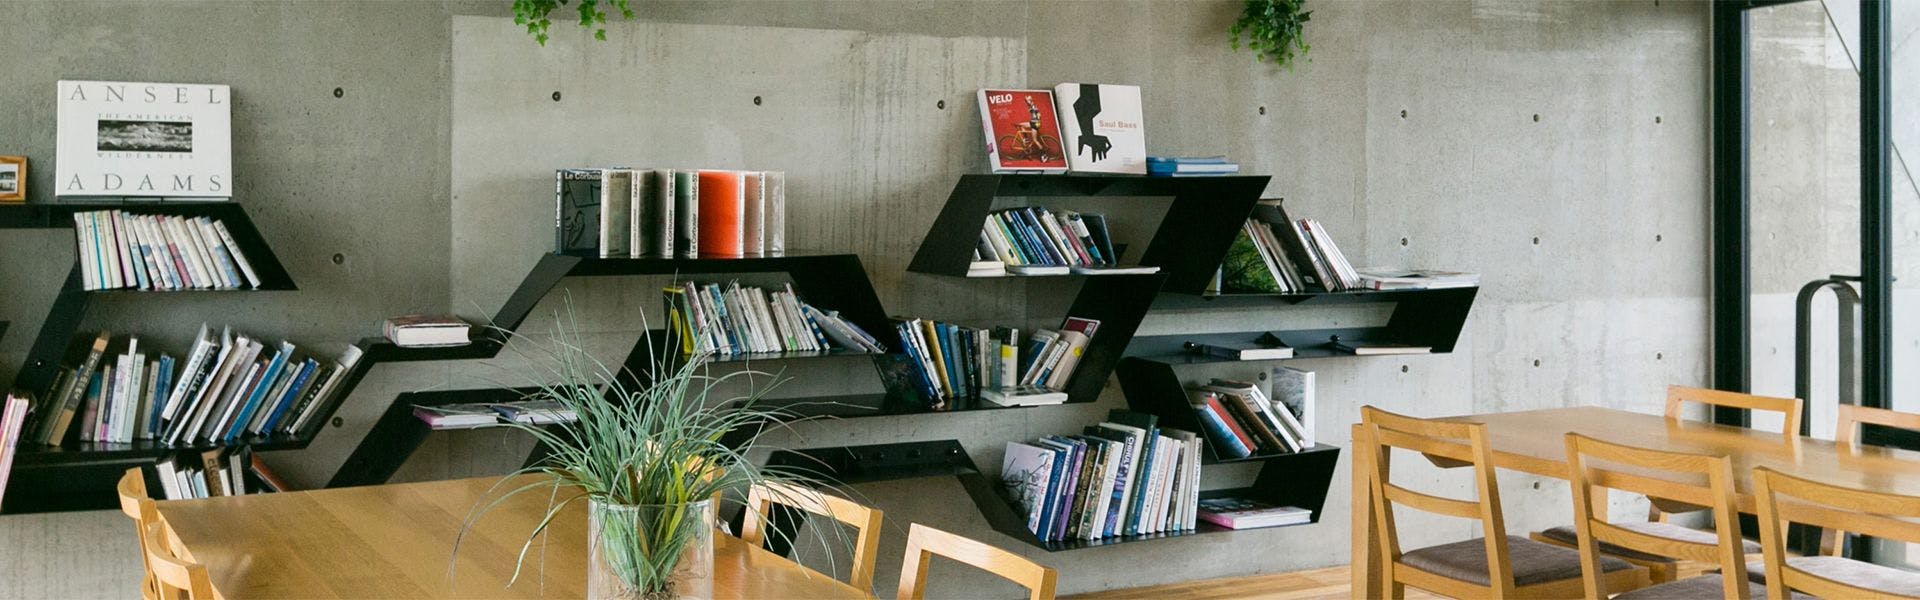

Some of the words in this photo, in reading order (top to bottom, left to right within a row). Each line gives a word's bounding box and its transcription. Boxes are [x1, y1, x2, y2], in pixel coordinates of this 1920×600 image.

[70, 84, 222, 104] ANSEL
[989, 93, 1013, 104] VELO
[1098, 119, 1116, 128] Saul
[1117, 121, 1137, 129] Bass
[564, 172, 574, 180] Le
[66, 173, 222, 192] ADAMS
[667, 242, 673, 251] Le
[691, 244, 697, 253] Le
